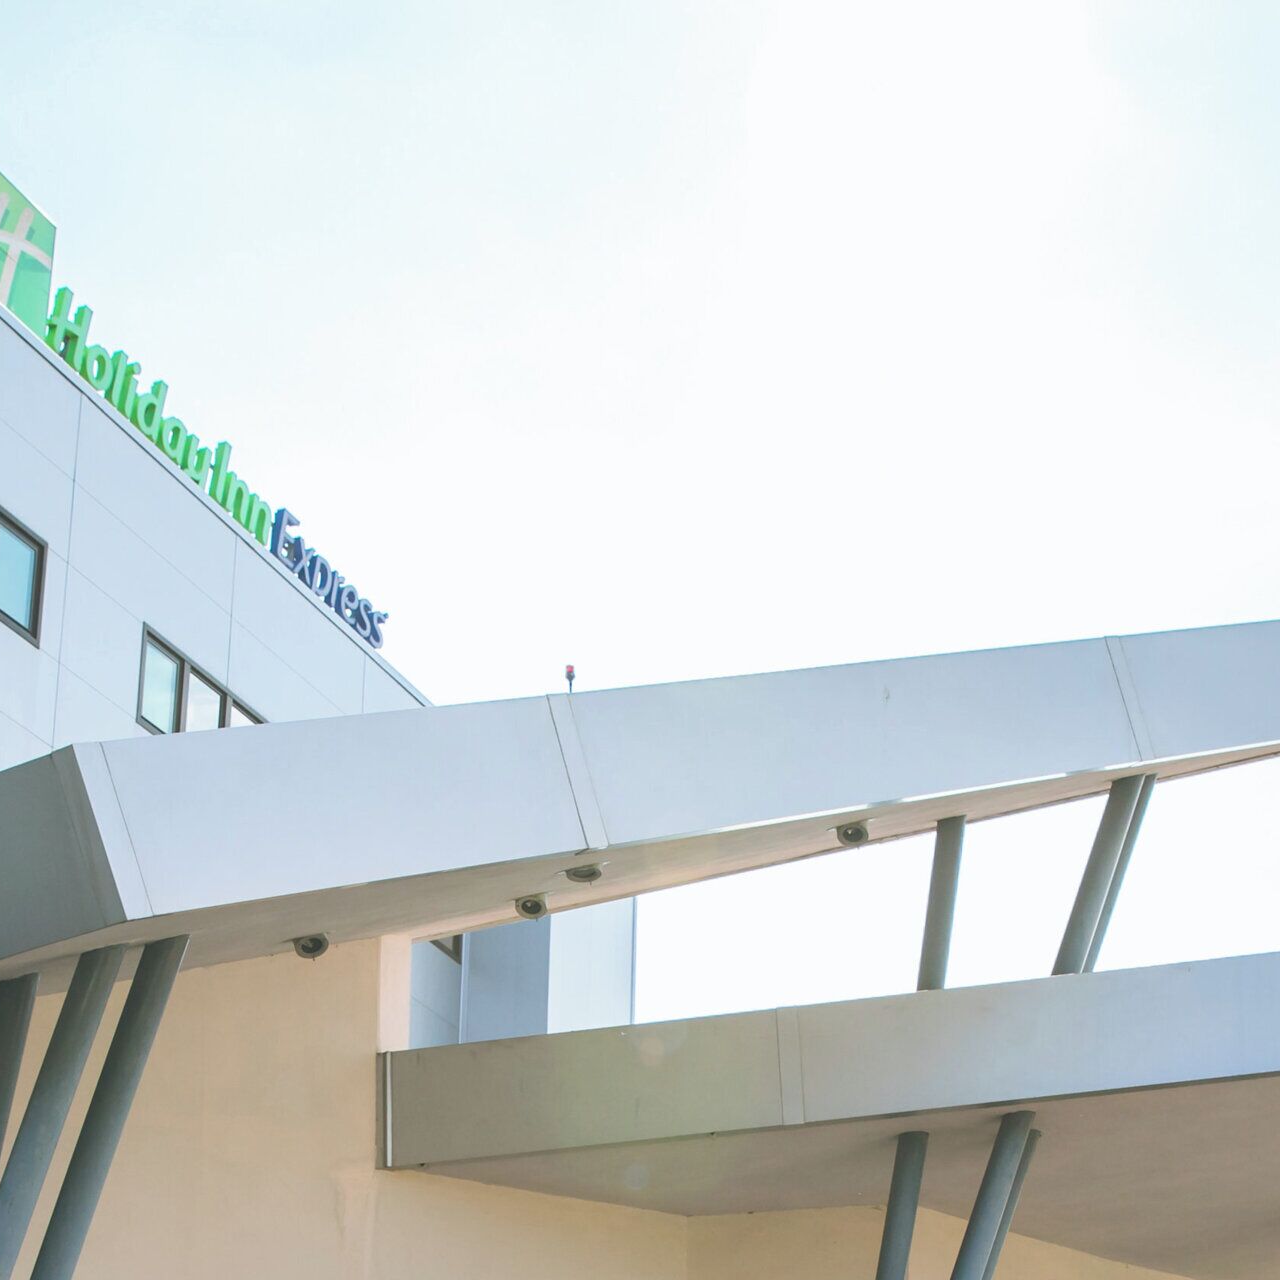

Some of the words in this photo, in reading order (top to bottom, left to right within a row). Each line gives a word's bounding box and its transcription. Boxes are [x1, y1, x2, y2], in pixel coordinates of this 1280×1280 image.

[46, 286, 212, 490] Holiday
[208, 441, 272, 547] Inn
[269, 507, 389, 650] Express
